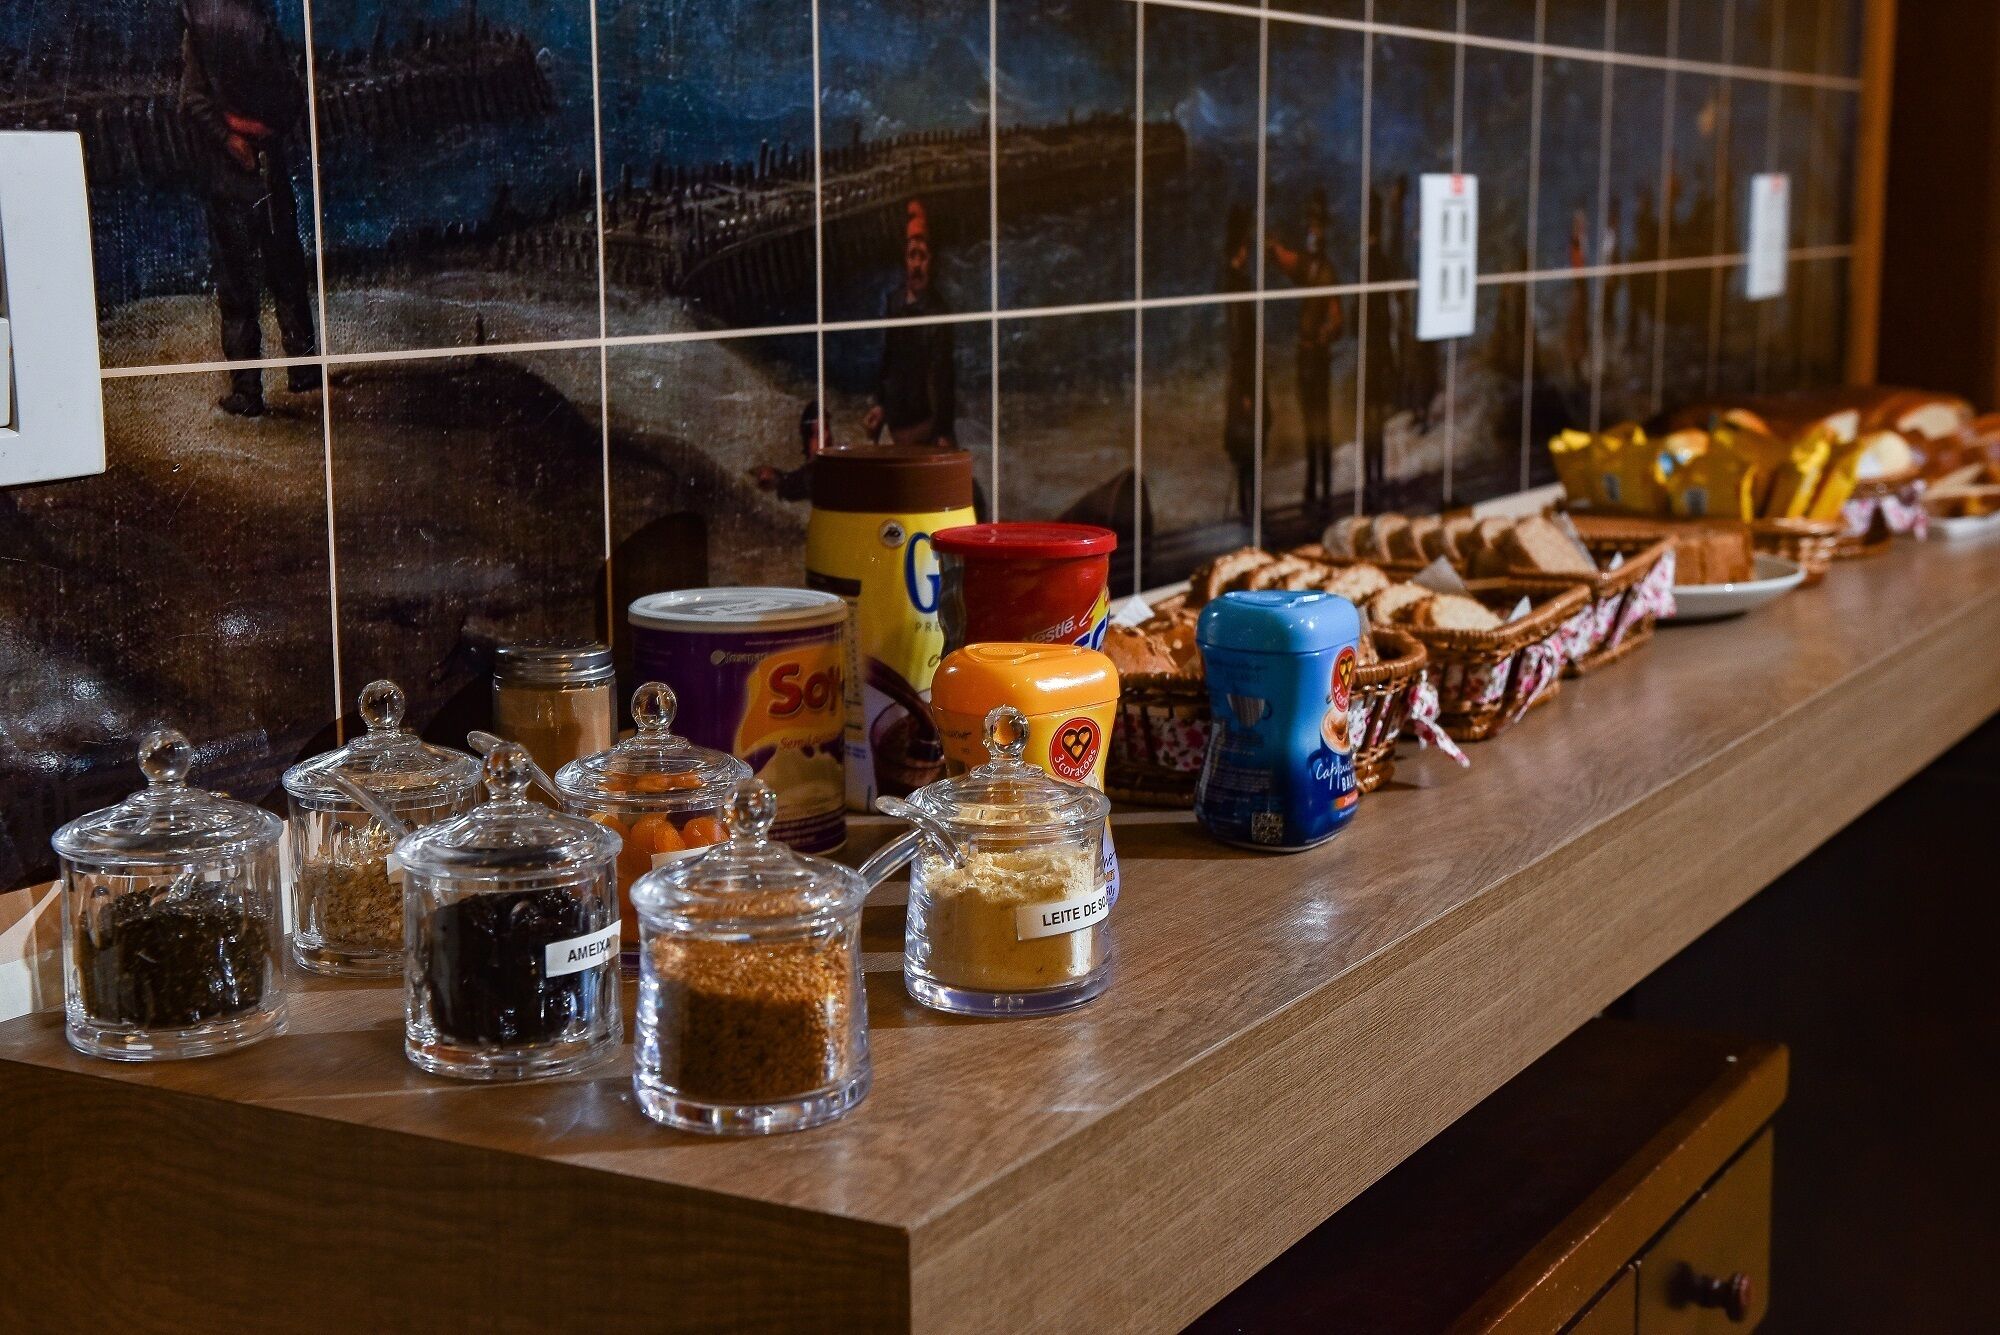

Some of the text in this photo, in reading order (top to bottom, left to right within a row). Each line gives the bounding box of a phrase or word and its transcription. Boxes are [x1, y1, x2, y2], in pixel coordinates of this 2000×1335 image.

[1054, 749, 1097, 777] 3 corações
[1042, 906, 1081, 927] LEITE
[1083, 901, 1097, 917] DE
[567, 936, 611, 963] AMEIXA
